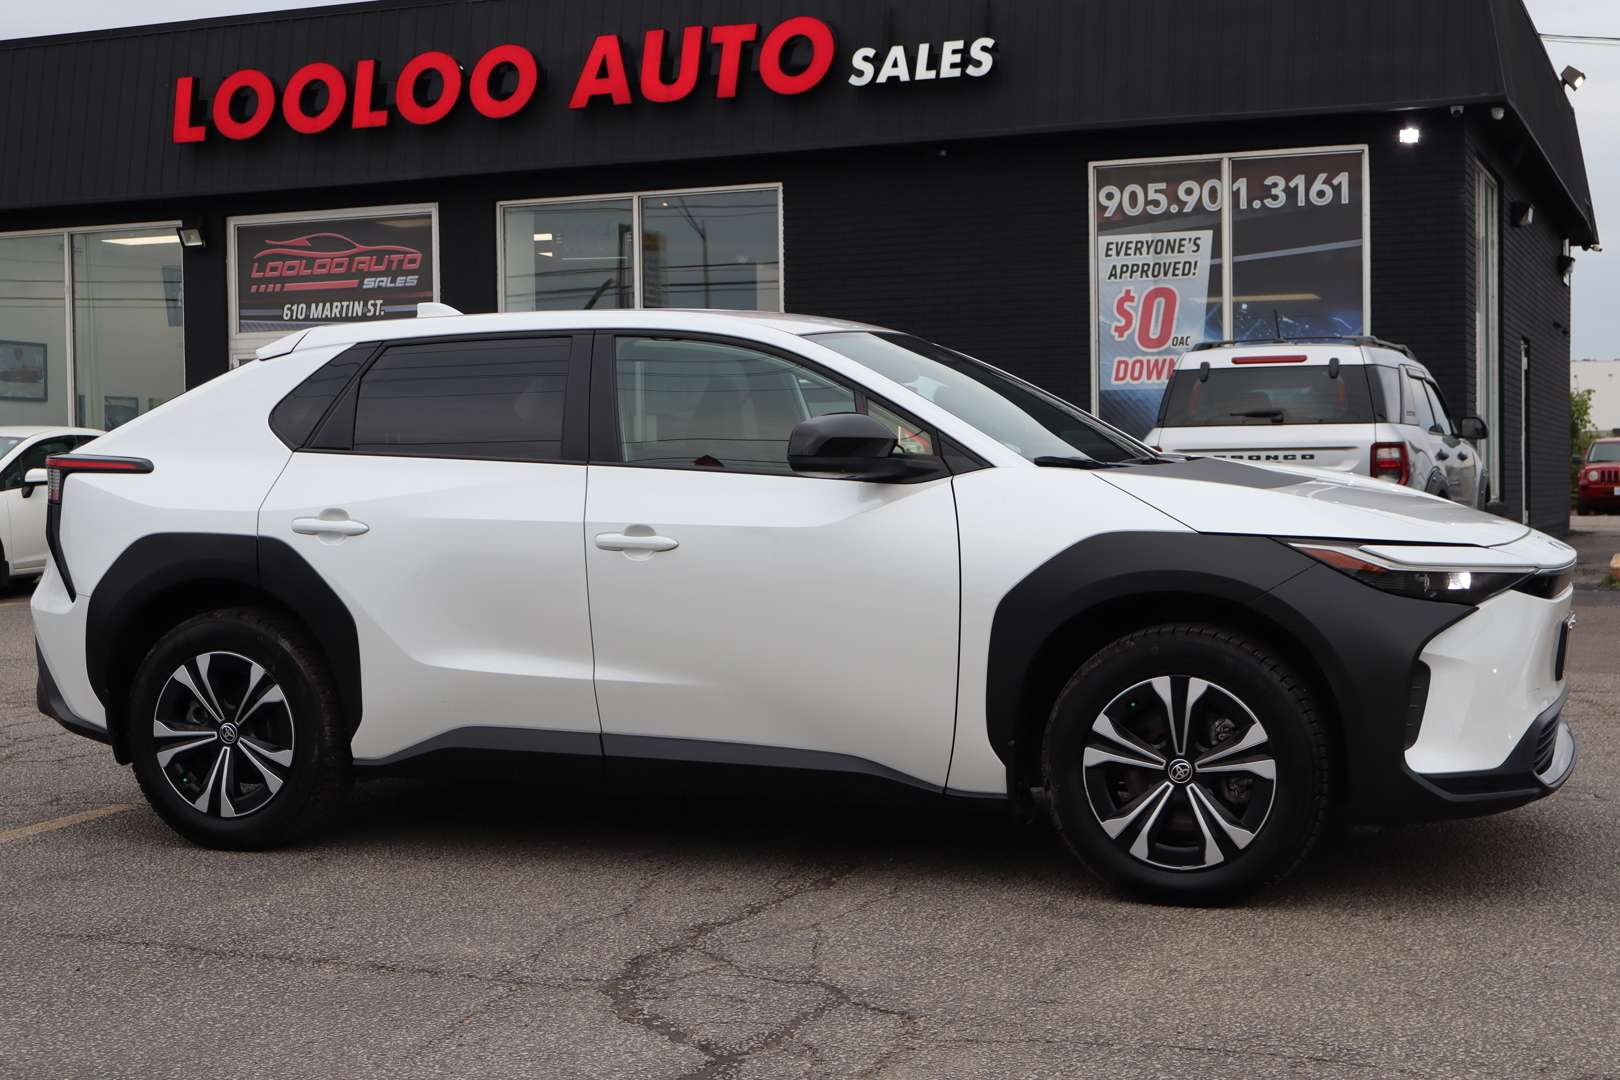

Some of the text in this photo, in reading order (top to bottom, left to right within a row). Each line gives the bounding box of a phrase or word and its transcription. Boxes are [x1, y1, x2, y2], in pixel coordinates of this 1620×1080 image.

[172, 16, 995, 144] LOOLOO AUTO SALES
[1099, 171, 1350, 217] 905.901.3161
[1104, 236, 1201, 258] EVERYONE'S
[251, 253, 423, 278] LOOLOO AUTO
[1107, 260, 1198, 281] APPROVED!
[362, 275, 419, 289] SALES
[282, 299, 385, 320] 610 MARTIN ST.
[1113, 287, 1191, 350] $0 OAC
